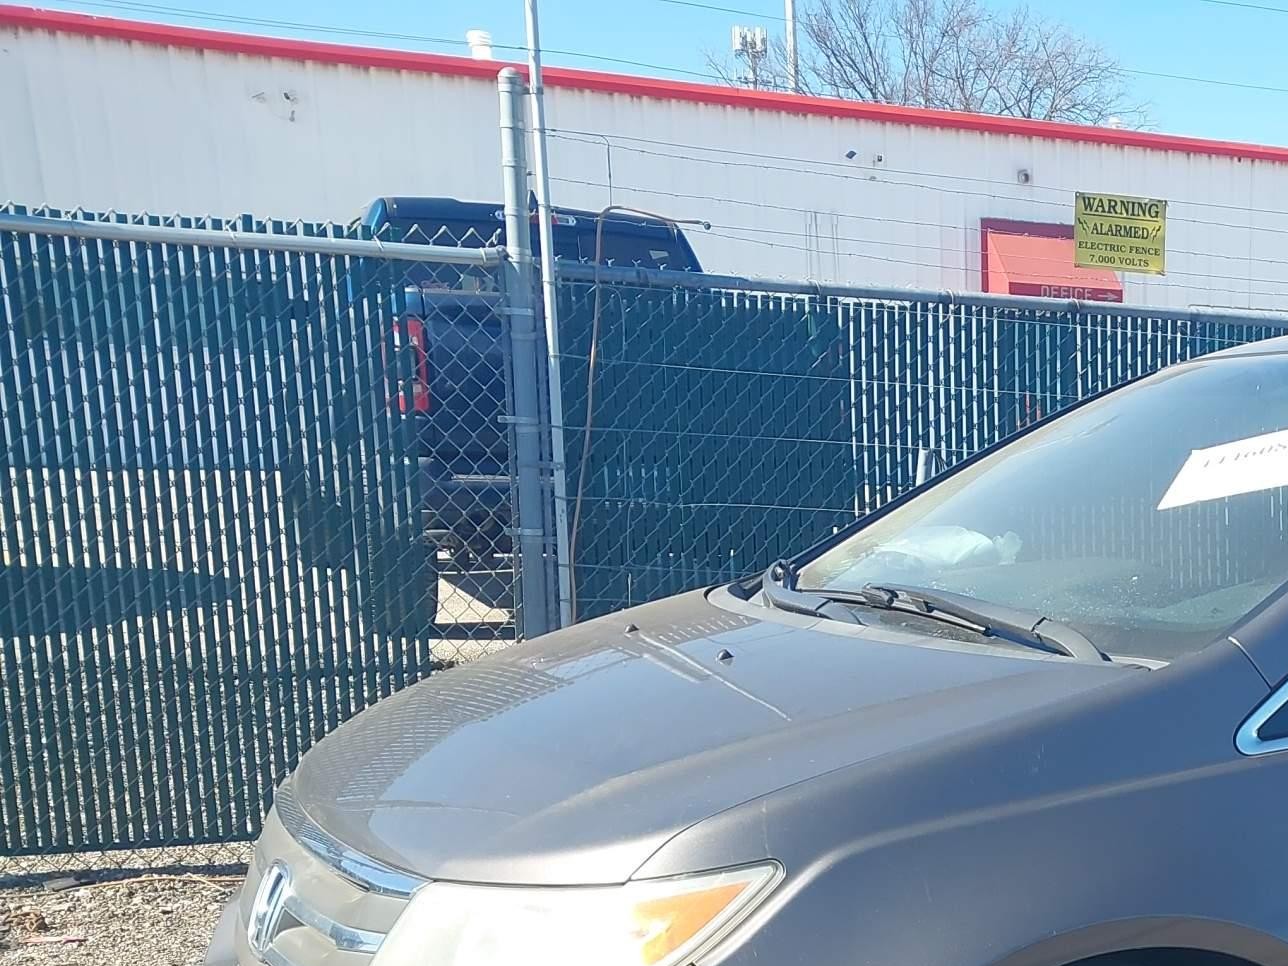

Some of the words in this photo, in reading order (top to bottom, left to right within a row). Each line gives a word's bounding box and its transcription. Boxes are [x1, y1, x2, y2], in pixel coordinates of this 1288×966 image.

[1082, 196, 1159, 218] WARNING
[1091, 222, 1149, 239] ALARMED
[1078, 241, 1126, 253] ELECTRIC
[1128, 246, 1160, 256] FENCE
[1118, 257, 1149, 267] VOLTS
